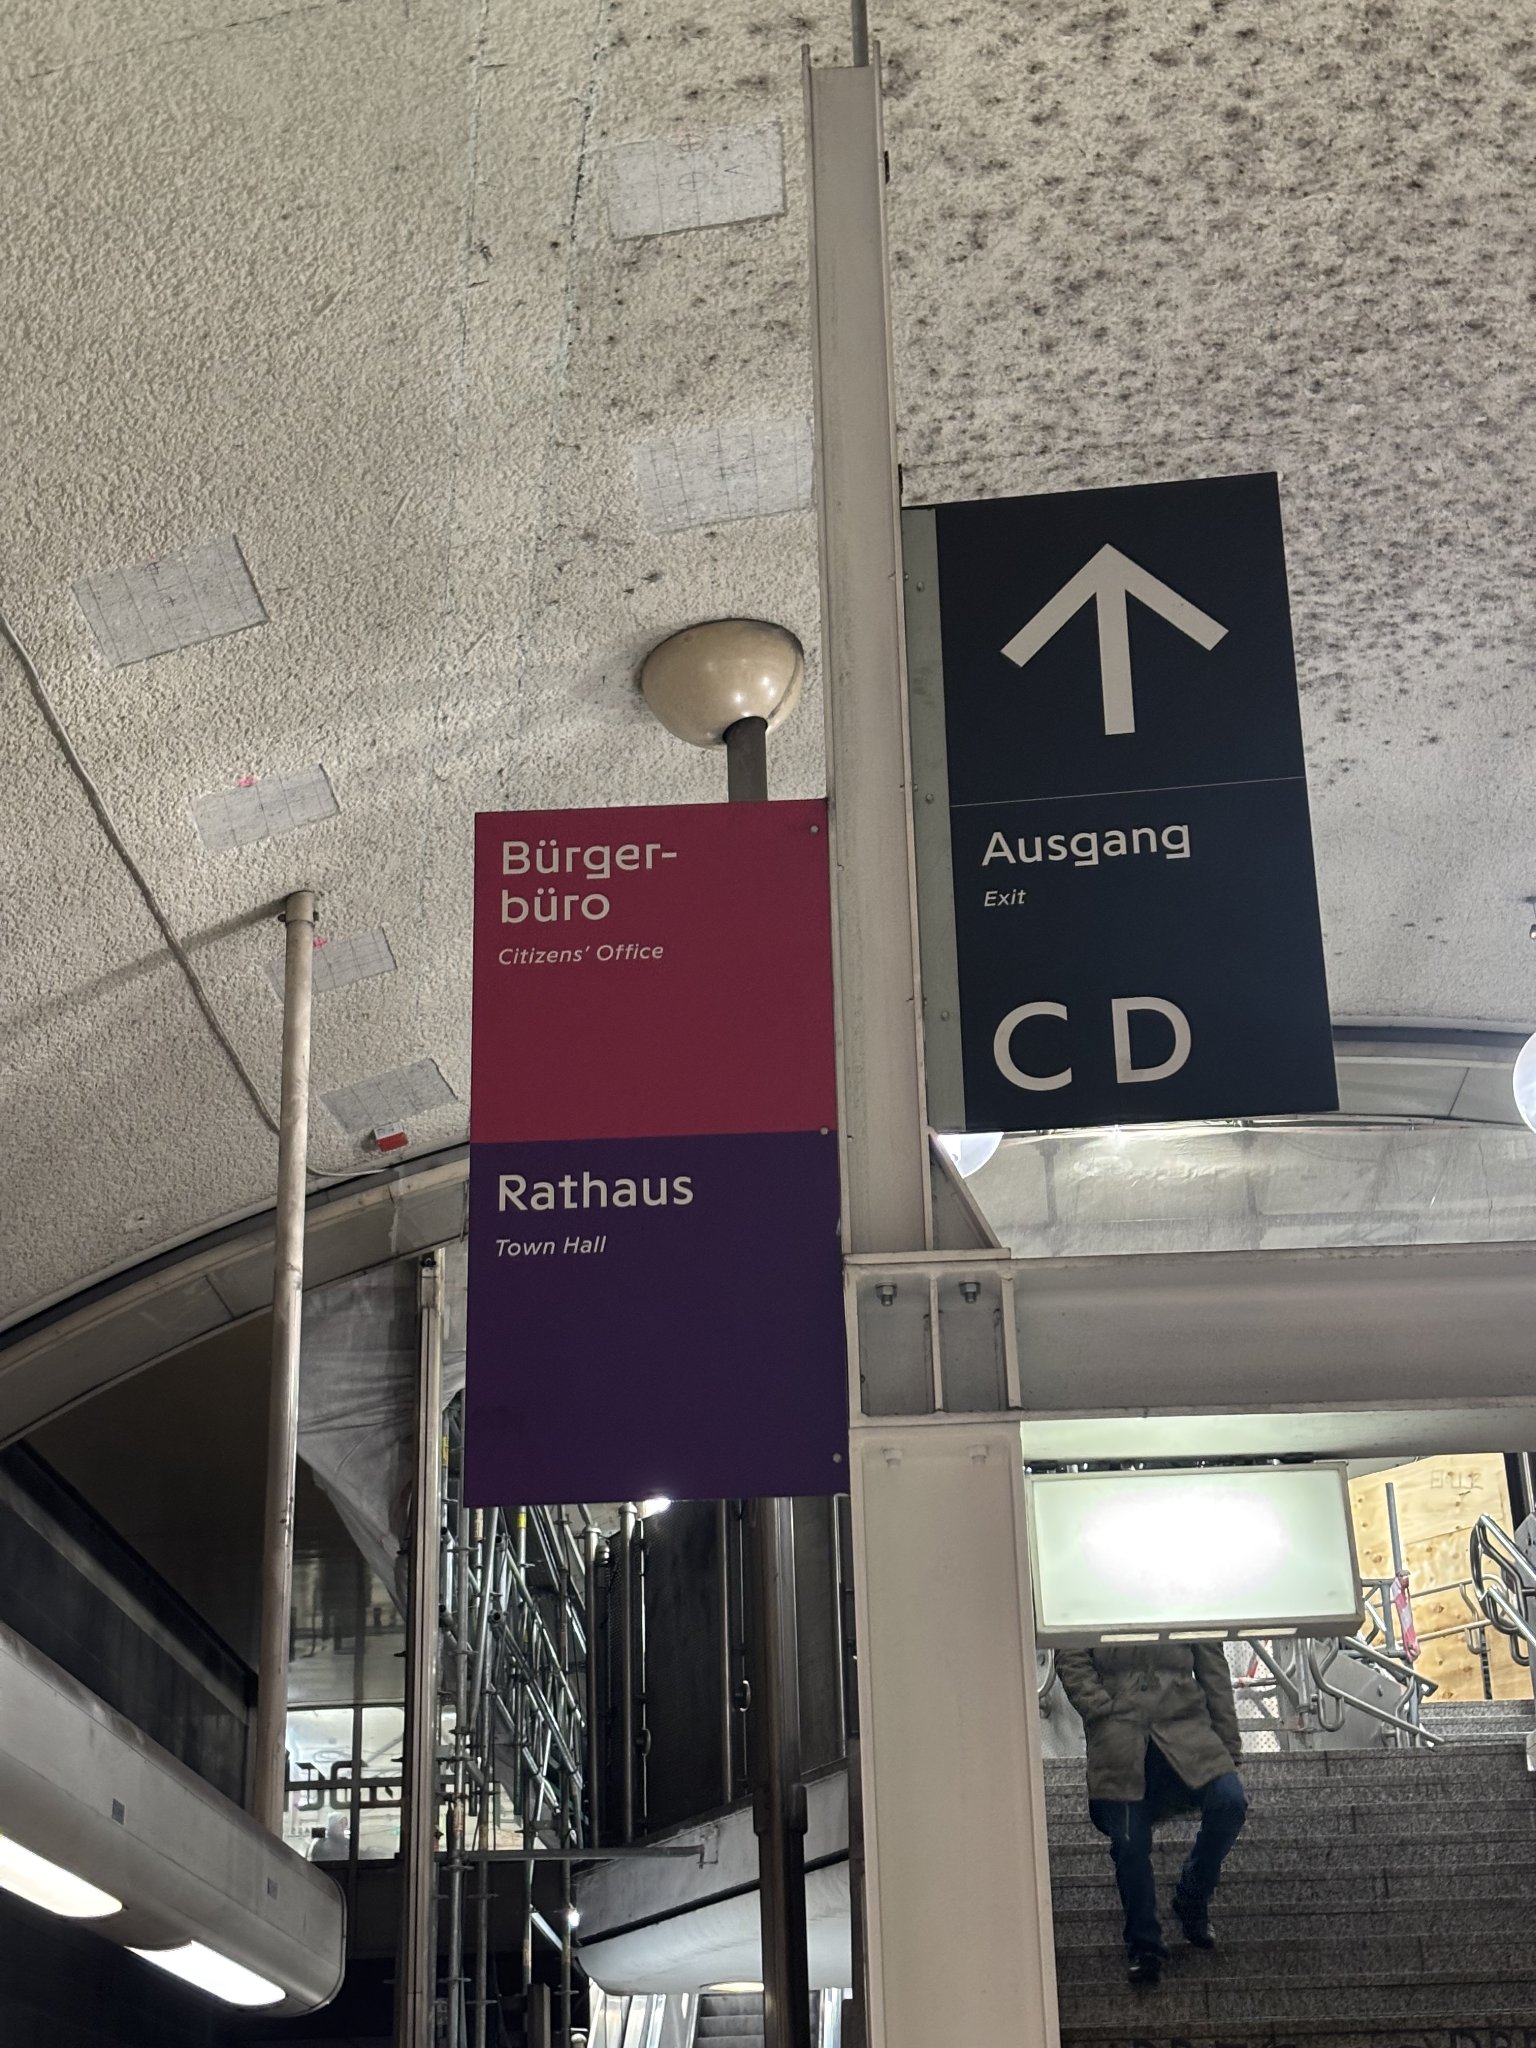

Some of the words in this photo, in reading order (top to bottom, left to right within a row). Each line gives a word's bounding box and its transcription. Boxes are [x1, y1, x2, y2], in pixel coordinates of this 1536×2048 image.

[503, 840, 677, 879] Bürger-
[982, 825, 1190, 866] Ausgang
[502, 888, 609, 923] büro
[984, 889, 1026, 906] Exit
[597, 944, 663, 961] Office
[994, 1002, 1072, 1091] C
[1112, 997, 1191, 1083] D
[499, 1172, 693, 1211] Rathaus
[496, 1239, 555, 1256] Town
[564, 1236, 606, 1253] Hall
